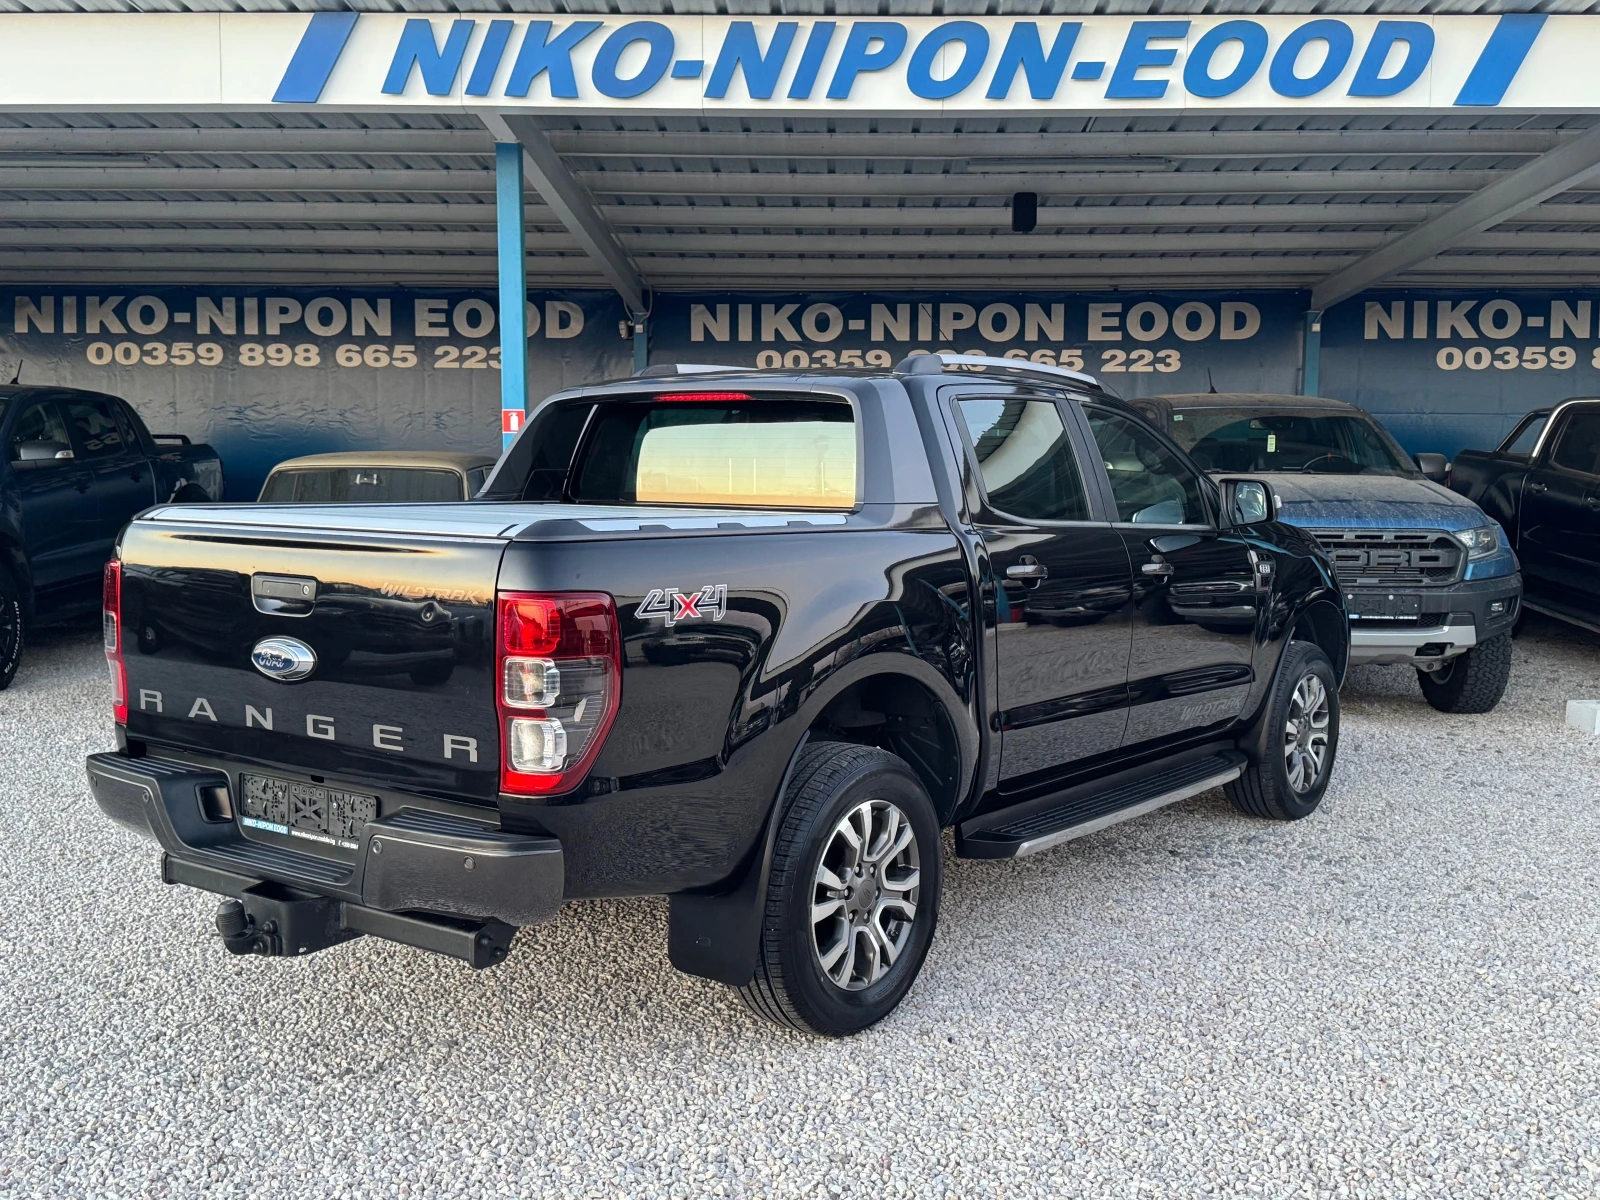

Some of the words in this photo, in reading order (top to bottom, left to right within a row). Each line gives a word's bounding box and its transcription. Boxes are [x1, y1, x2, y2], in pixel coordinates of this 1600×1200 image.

[381, 18, 1435, 99] NIKO-NIPON-EOOD
[14, 295, 392, 337] NIKO-NIPON
[690, 302, 1067, 342] NIKO-NIPON
[1087, 302, 1261, 341] EOOD
[1364, 299, 1600, 340] NIKO-N
[86, 341, 223, 366] 00359
[238, 343, 321, 367] 898
[335, 344, 418, 368] 665
[756, 349, 892, 370] 00359
[1101, 349, 1182, 373] 223
[1436, 346, 1577, 370] 00359
[1328, 550, 1447, 567] ORD
[380, 582, 480, 604] WILDTRAK
[258, 649, 286, 668] Ford
[139, 688, 478, 763] RANGER
